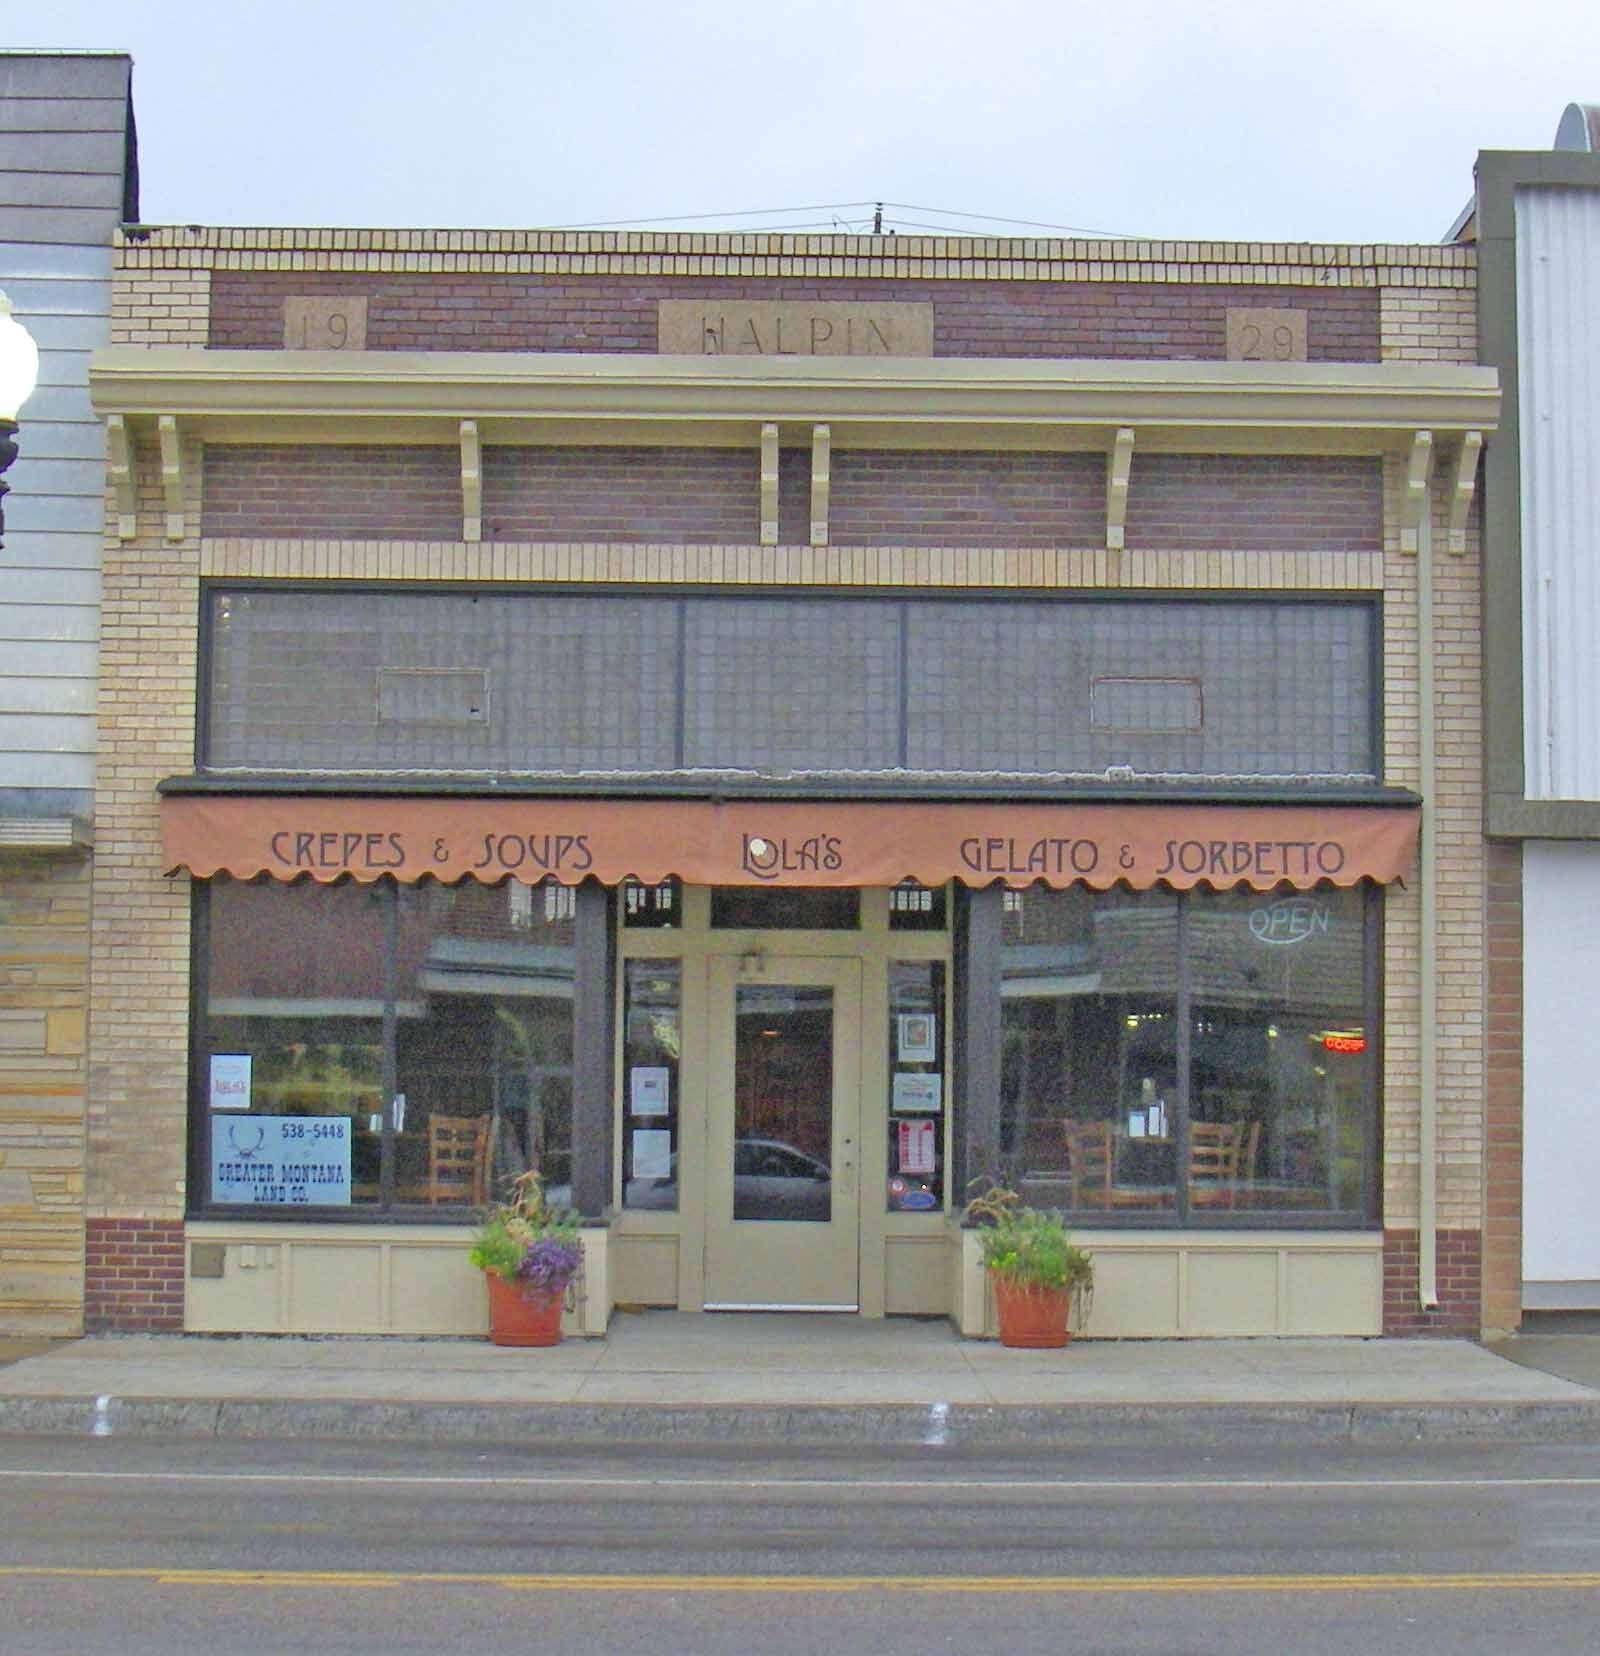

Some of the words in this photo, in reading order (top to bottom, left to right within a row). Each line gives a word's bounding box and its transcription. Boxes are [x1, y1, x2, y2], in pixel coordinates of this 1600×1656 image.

[301, 313, 348, 350] 19
[702, 316, 893, 354] HALPIN
[1240, 324, 1293, 361] 29
[271, 832, 405, 868] CREPES
[433, 838, 449, 863] &
[474, 833, 594, 870] SOUPS
[741, 833, 843, 879] LOLA'S
[960, 838, 1098, 873] GELATO
[1119, 844, 1136, 869] &
[1156, 840, 1345, 875] SORBETTO
[1248, 900, 1331, 944] OPEN
[281, 1123, 345, 1139] 538-5448
[281, 1163, 345, 1183] MONTANA
[254, 1185, 286, 1202] LAND
